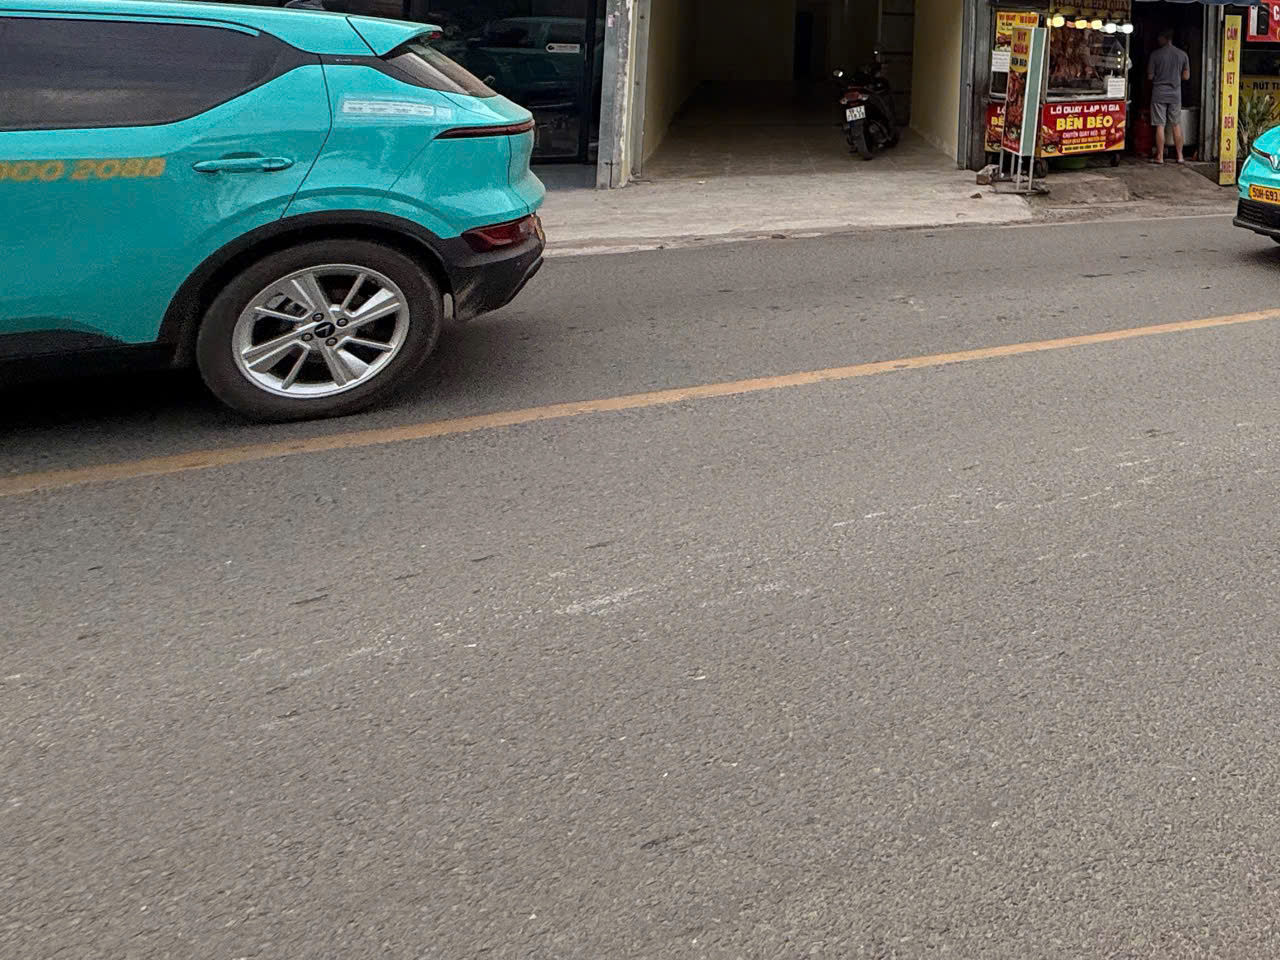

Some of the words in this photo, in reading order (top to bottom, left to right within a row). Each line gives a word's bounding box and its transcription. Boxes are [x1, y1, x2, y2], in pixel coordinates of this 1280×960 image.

[1228, 94, 1233, 107] 1
[1063, 105, 1083, 114] QUAY
[1225, 138, 1231, 151] 3
